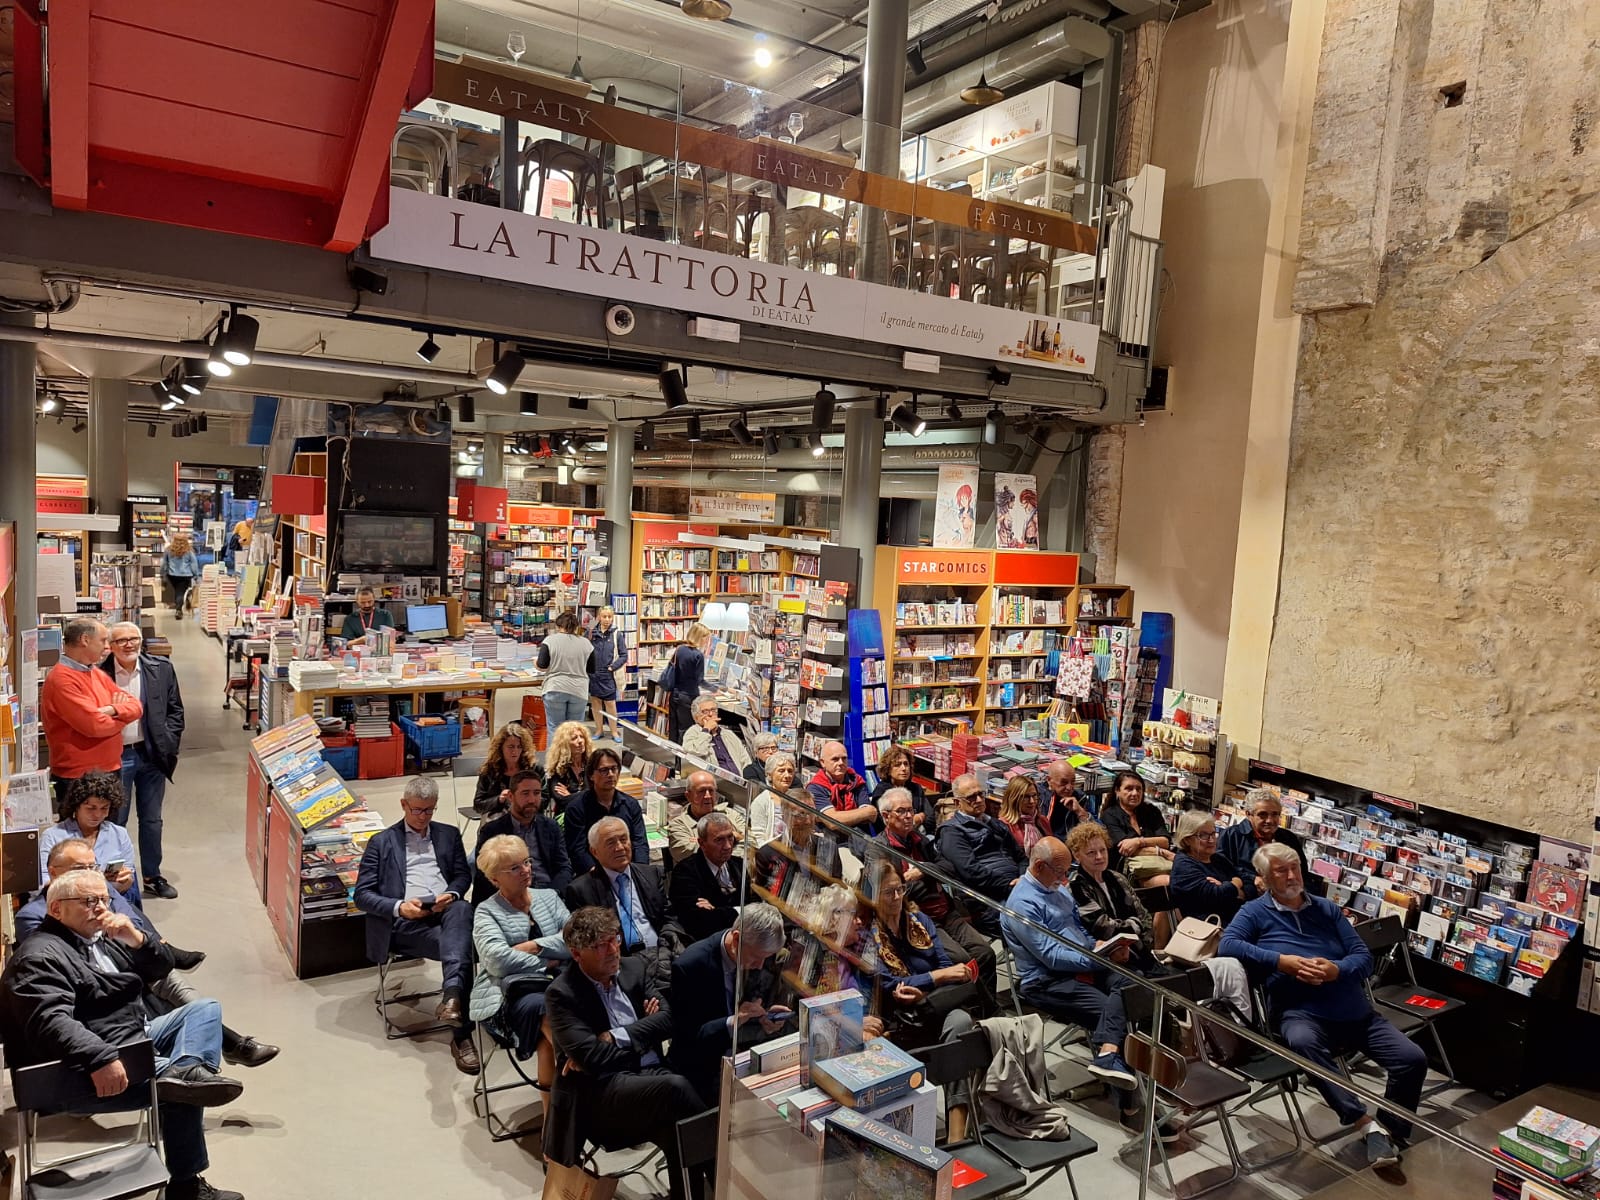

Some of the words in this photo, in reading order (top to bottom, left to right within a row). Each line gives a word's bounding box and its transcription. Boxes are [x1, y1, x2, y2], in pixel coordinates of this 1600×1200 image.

[465, 78, 591, 127] EATALY
[756, 153, 850, 191] EATALY
[973, 207, 1048, 237] EATALY
[449, 211, 520, 259] LA
[536, 228, 817, 313] TRATTORIA
[752, 305, 766, 317] DI
[767, 308, 814, 326] EATALY
[880, 312, 887, 324] il
[887, 316, 916, 329] grande
[917, 321, 949, 334] mercato
[950, 323, 959, 336] di
[960, 325, 985, 343] Eataly
[735, 501, 761, 513] EATALY
[903, 561, 987, 574] STARCOMICS
[1115, 631, 1122, 642] 9
[1109, 682, 1119, 691] 12
[1109, 700, 1118, 709] 13
[863, 1121, 889, 1138] Wild
[889, 1133, 915, 1150] Seas
